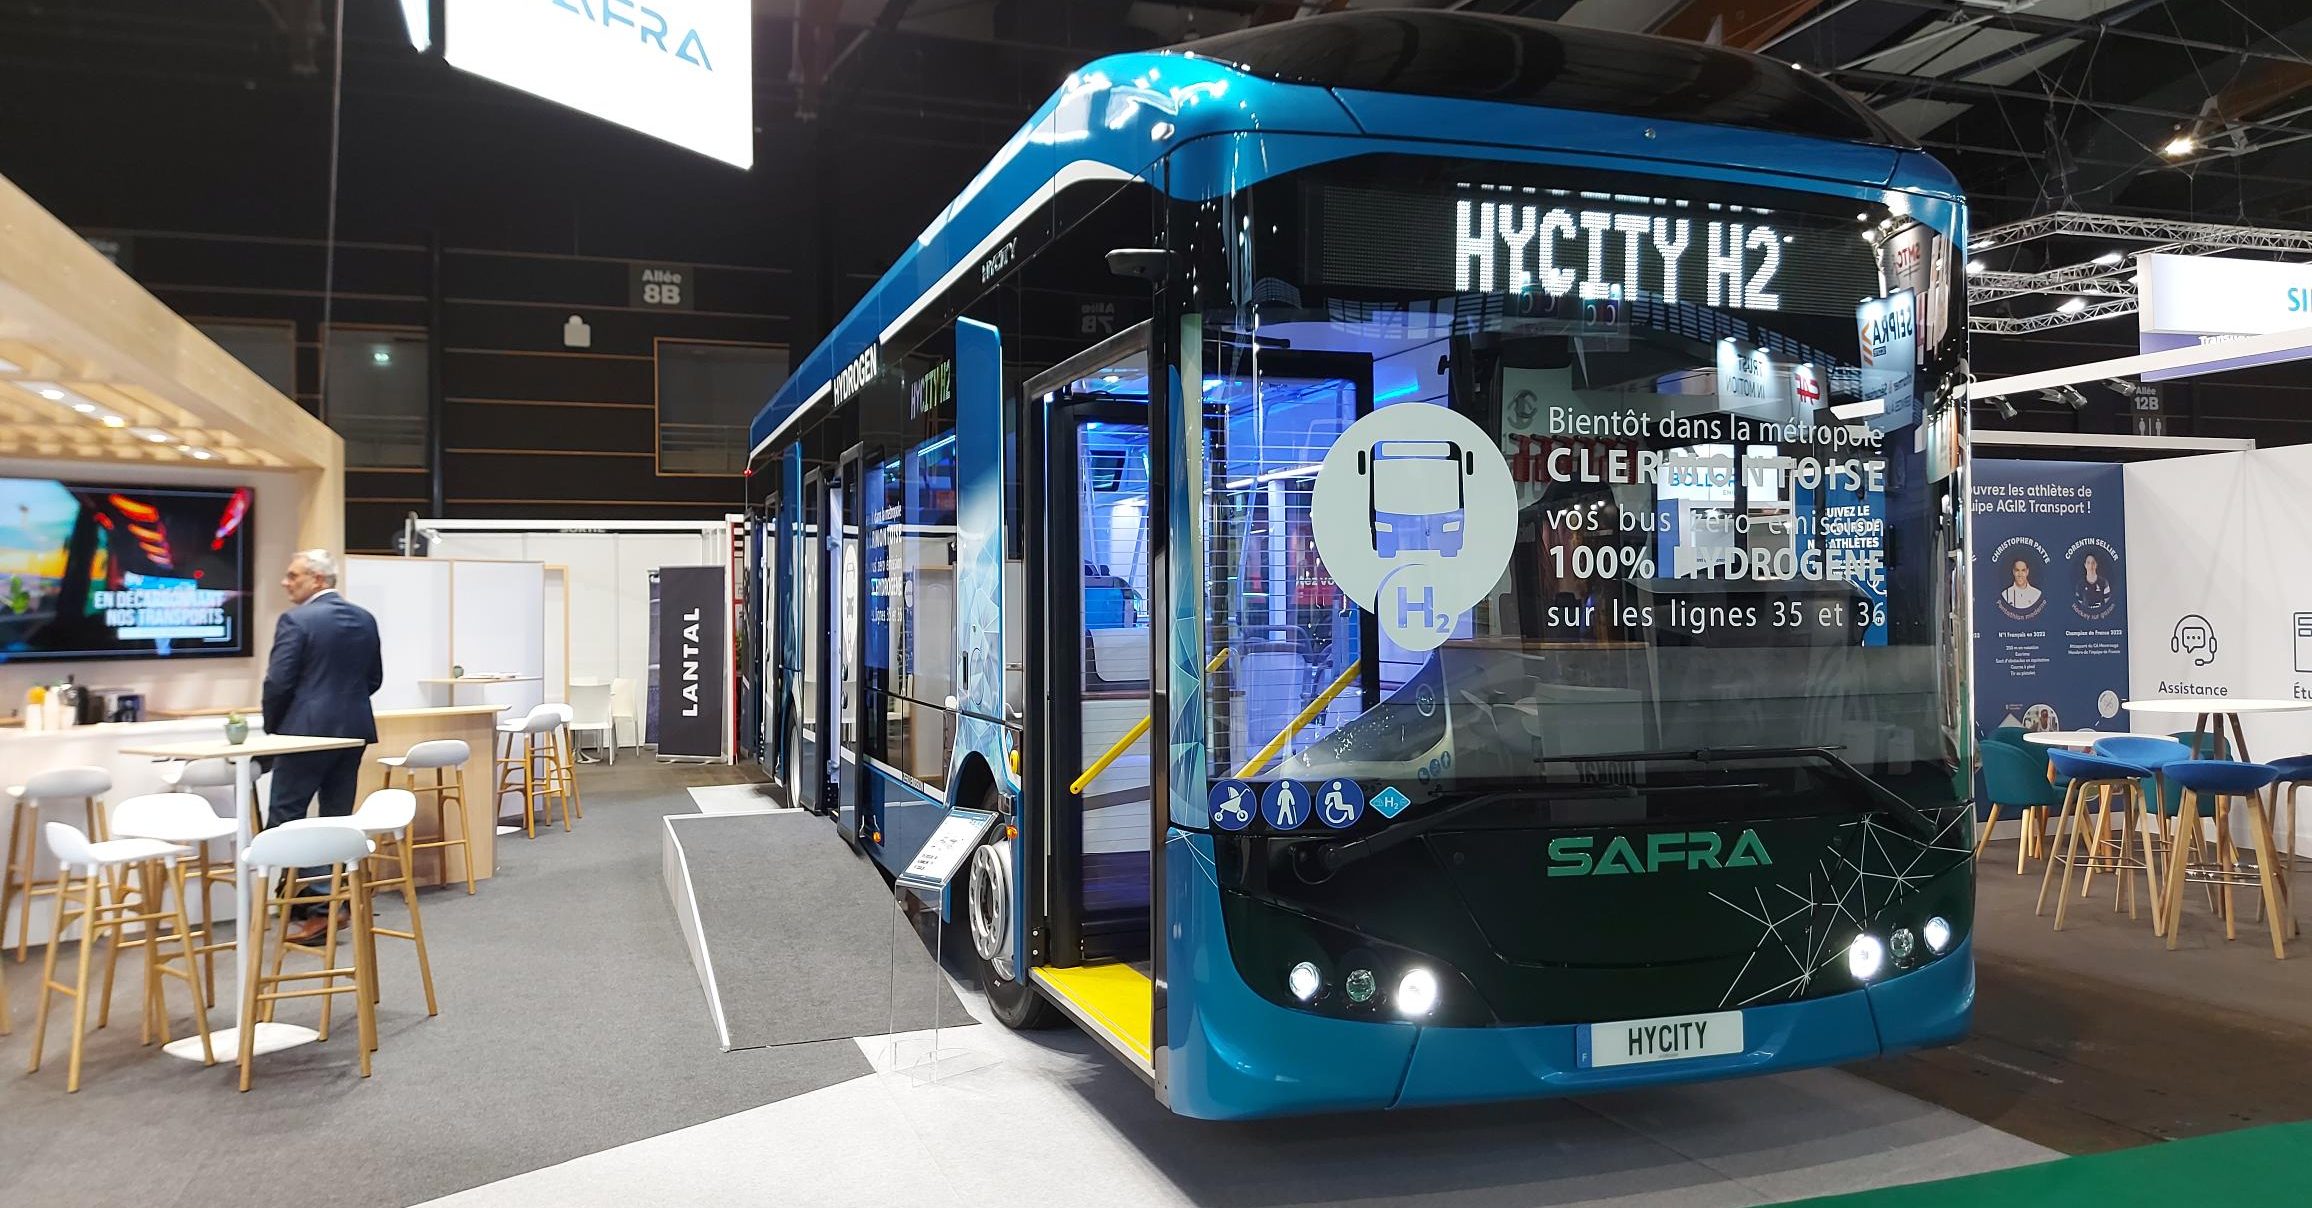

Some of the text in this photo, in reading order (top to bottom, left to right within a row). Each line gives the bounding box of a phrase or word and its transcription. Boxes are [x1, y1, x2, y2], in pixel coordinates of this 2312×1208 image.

[981, 236, 1018, 284] HYCITY
[1456, 200, 1780, 311] HYCITY H2
[643, 284, 681, 305] 8B
[2287, 287, 2312, 312] SI
[833, 343, 877, 407] HYDROGEN
[910, 366, 939, 421] HYCITY
[2134, 397, 2159, 410] 12B
[1549, 406, 1884, 451] Bientôt dans la métropole
[1547, 447, 1886, 492] CLERMONTOISE
[2008, 483, 2024, 497] les
[2027, 484, 2075, 498] athlètes
[2077, 485, 2092, 498] de
[1547, 504, 1884, 537] vos bus zéro émission
[1858, 505, 1870, 517] LE
[1997, 500, 2027, 513] AGIR
[2029, 499, 2085, 516] Transport
[1549, 545, 1655, 580] 100%
[2034, 541, 2050, 564] PATTE
[2065, 537, 2119, 561] CORENTIN SELLIER
[94, 590, 115, 609] EN
[106, 608, 134, 626] NOS
[1547, 599, 1885, 634] sur les lignes 35 et 36
[682, 607, 700, 717] LANTAL
[2158, 681, 2228, 696] Assistance
[1548, 829, 1772, 876] SAFRA
[1629, 1021, 1707, 1055] HYCITY
[1582, 1053, 1588, 1062] F
